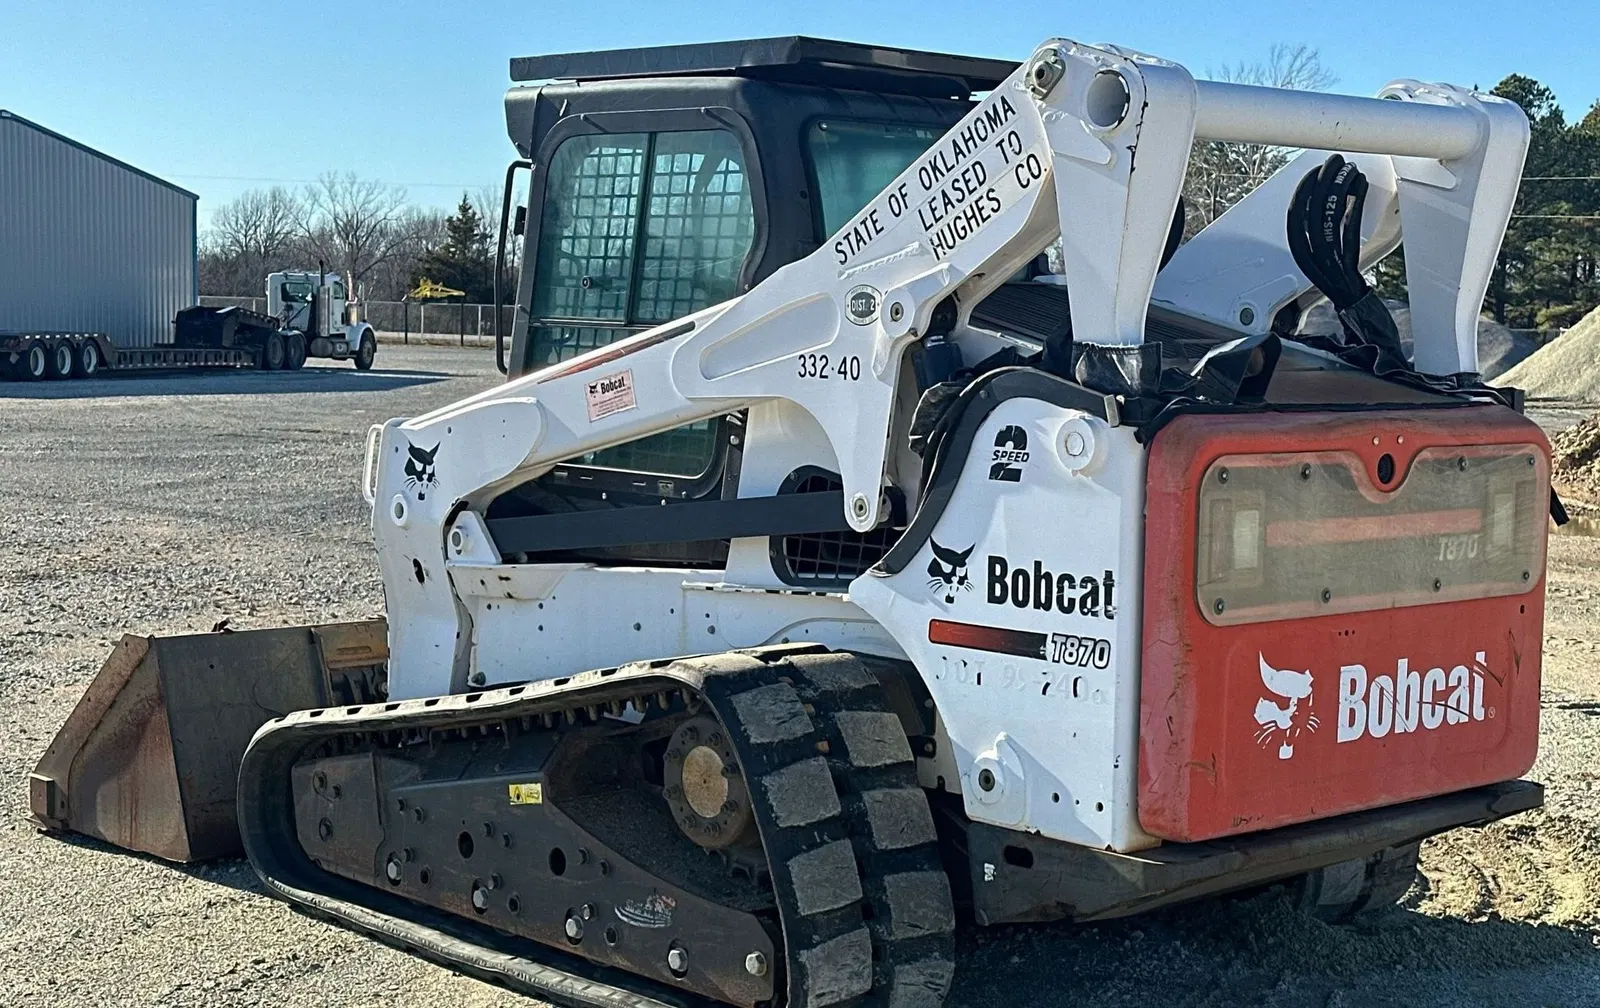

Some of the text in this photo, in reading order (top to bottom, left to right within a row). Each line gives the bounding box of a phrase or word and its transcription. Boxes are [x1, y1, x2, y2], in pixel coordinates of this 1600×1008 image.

[834, 95, 1017, 265] STATE OF OKLAHOMA
[918, 130, 1023, 232] LEASED TO
[929, 153, 1048, 261] HUGHES CO.
[870, 299, 875, 311] 2
[600, 376, 625, 394] Bobcat
[992, 449, 1030, 463] SPEED
[1439, 533, 1480, 561] T870
[987, 555, 1117, 620] Bobcat
[1051, 632, 1111, 670] T870
[1337, 651, 1487, 743] Bobcat
